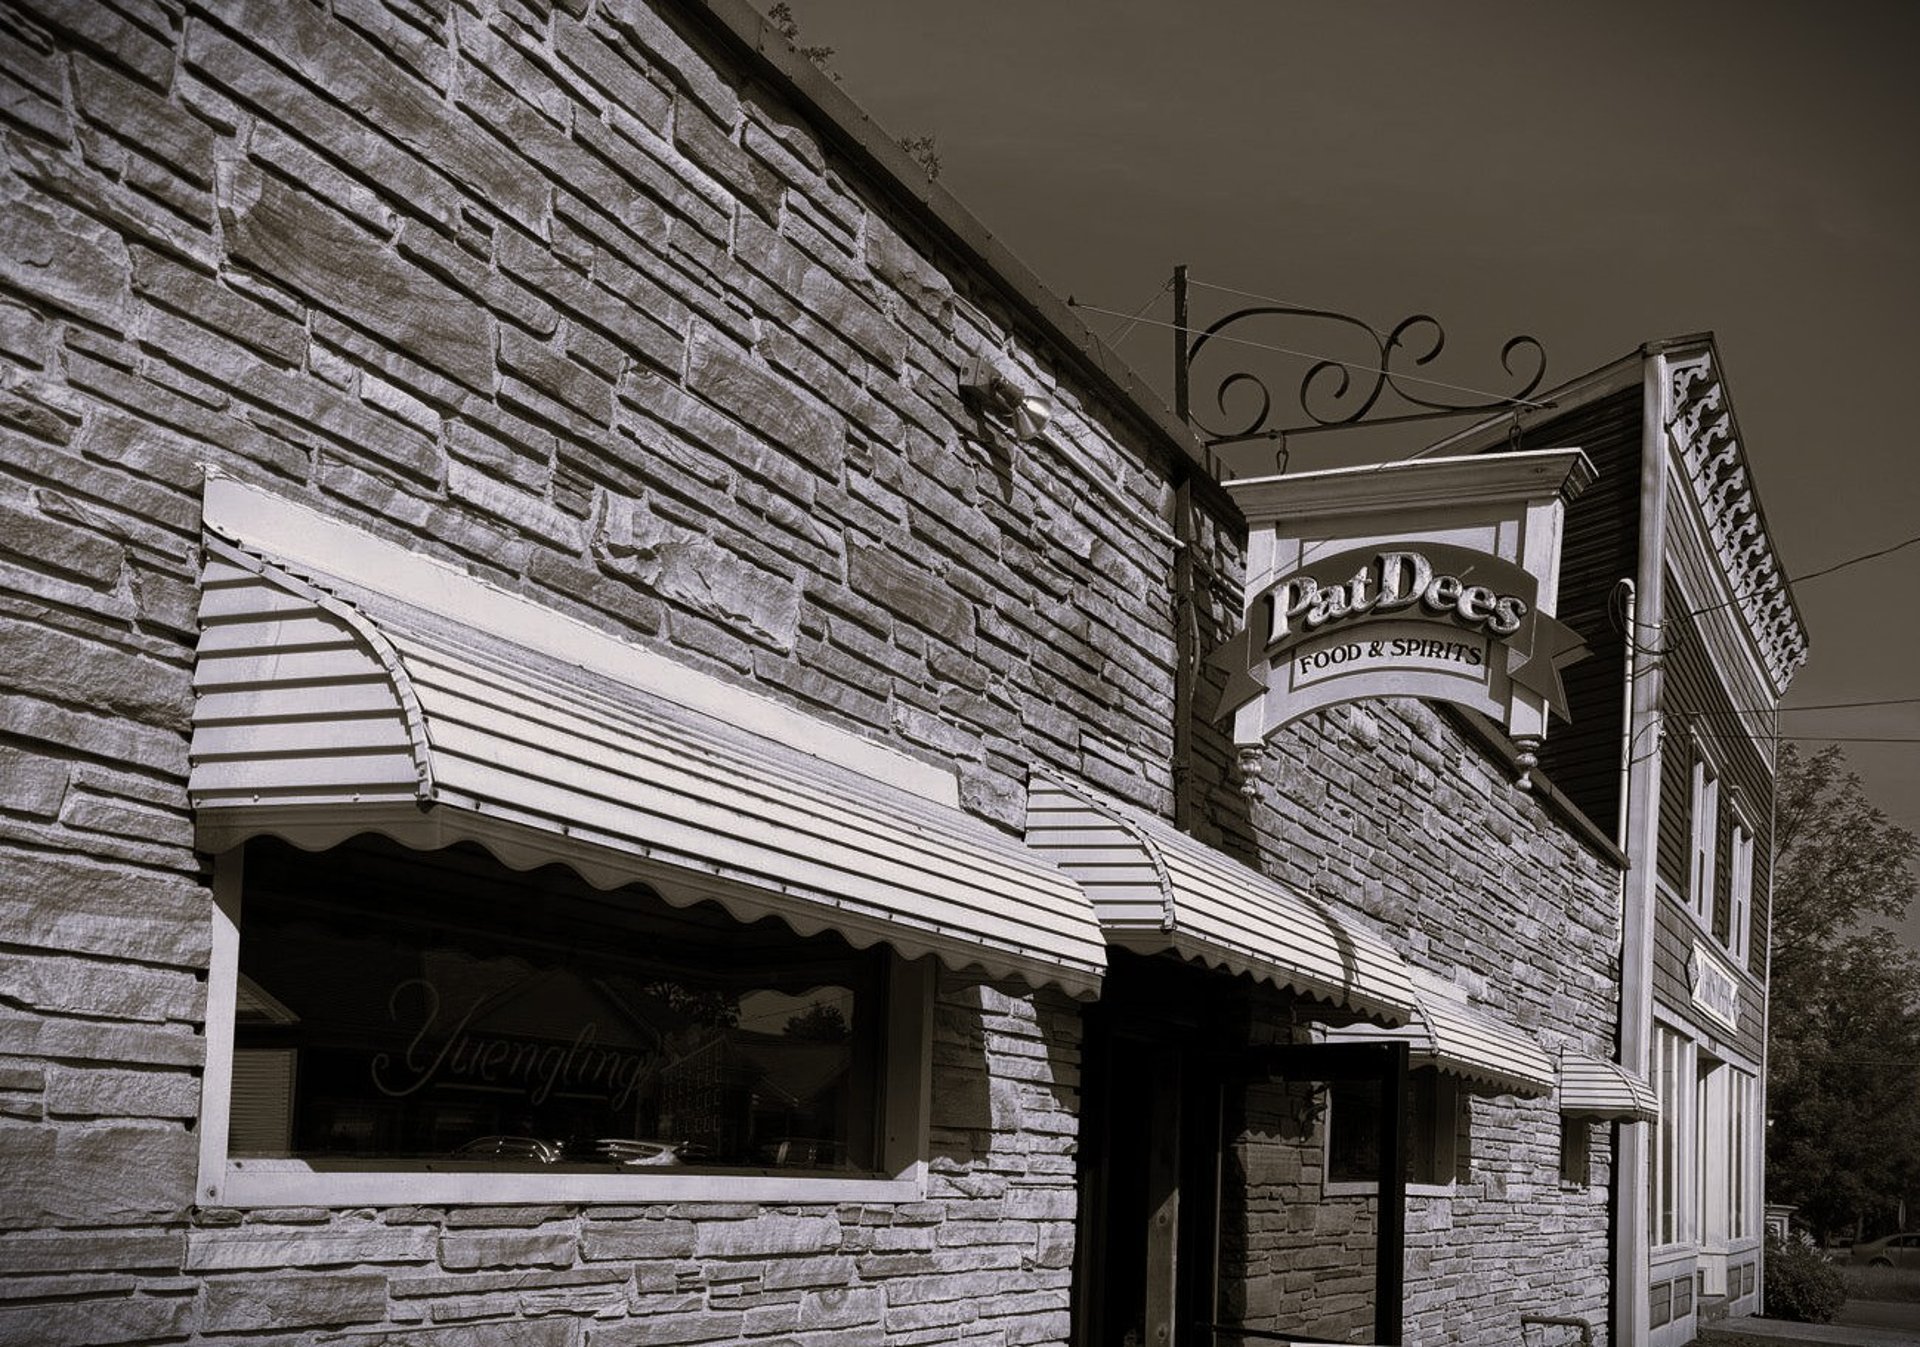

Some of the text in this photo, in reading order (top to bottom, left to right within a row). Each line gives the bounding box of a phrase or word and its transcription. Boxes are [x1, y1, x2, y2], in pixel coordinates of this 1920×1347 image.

[1267, 551, 1528, 645] Pat Dees
[1300, 638, 1483, 674] FOOD & SPIRITS
[371, 977, 651, 1112] Yuengling
